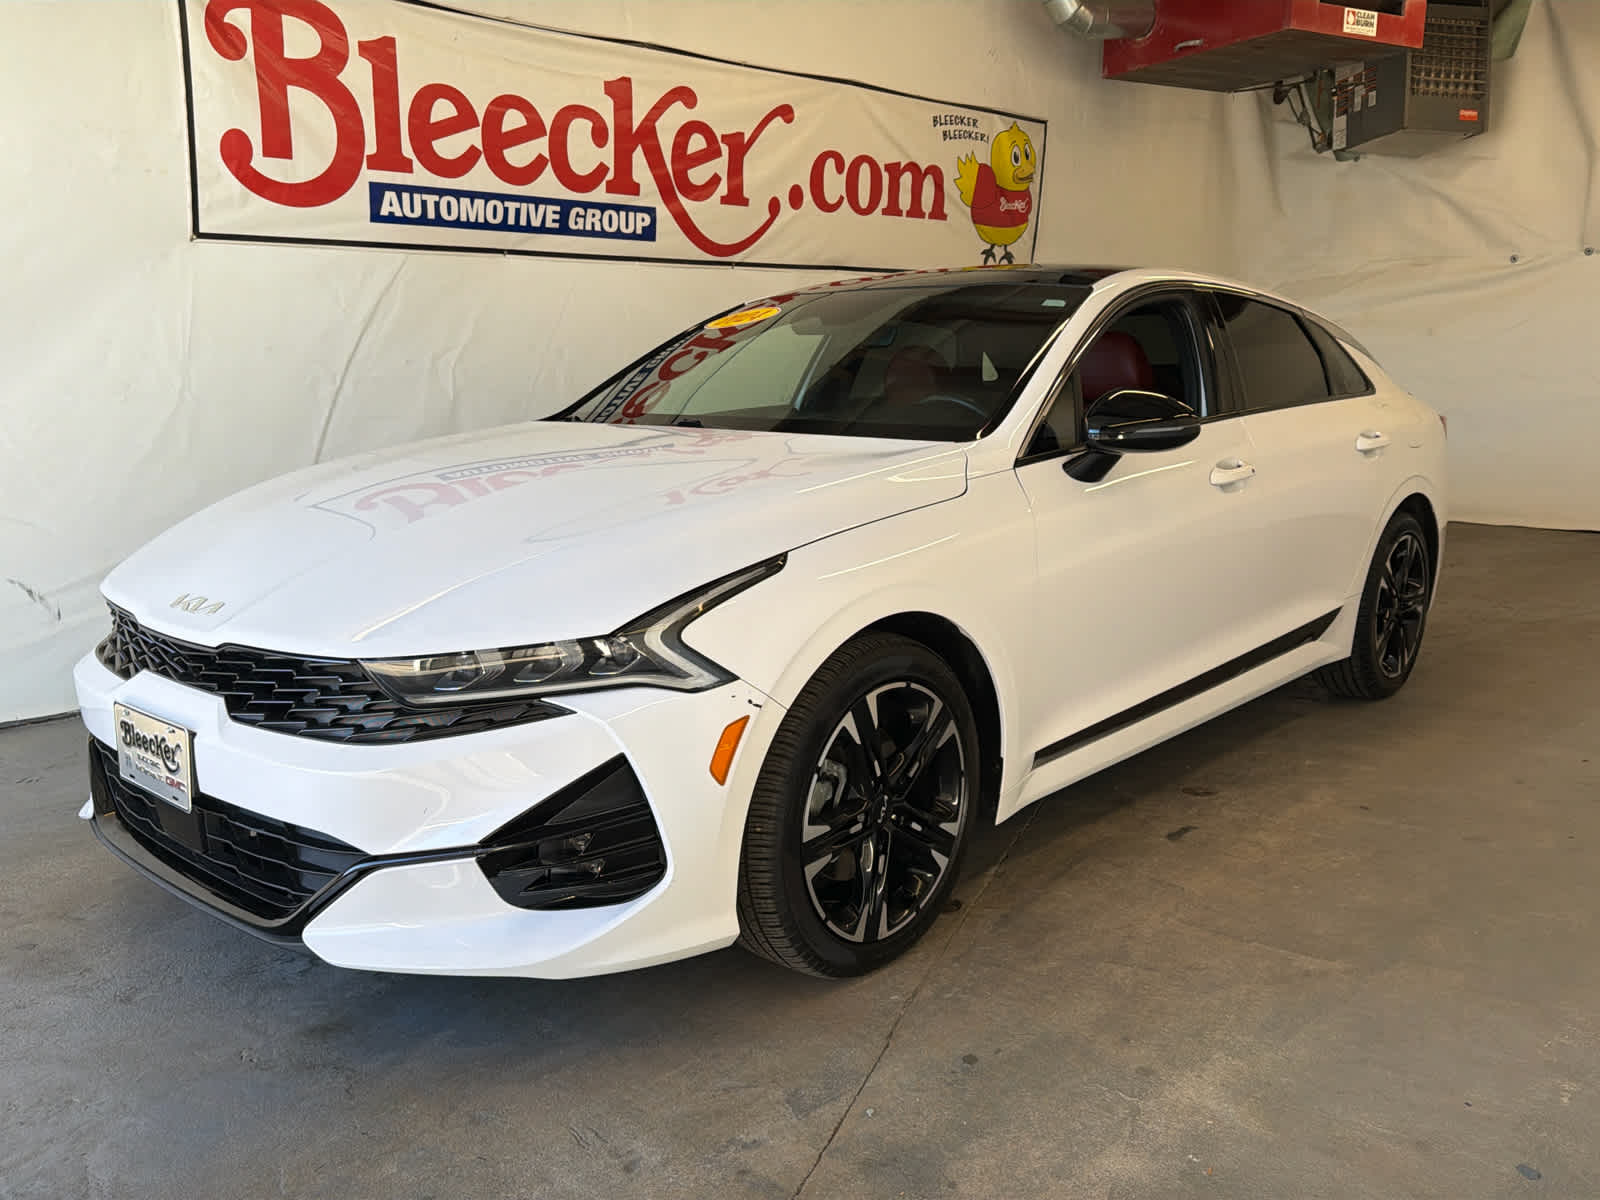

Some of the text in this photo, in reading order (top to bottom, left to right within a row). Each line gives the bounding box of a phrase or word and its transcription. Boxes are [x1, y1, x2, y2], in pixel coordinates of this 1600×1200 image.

[1356, 11, 1376, 20] CLEAN
[1356, 19, 1375, 28] BURN
[932, 114, 979, 128] BLEECKER
[942, 129, 990, 144] BLEECKER!
[380, 190, 652, 235] AUTOMOTIVE GROUP
